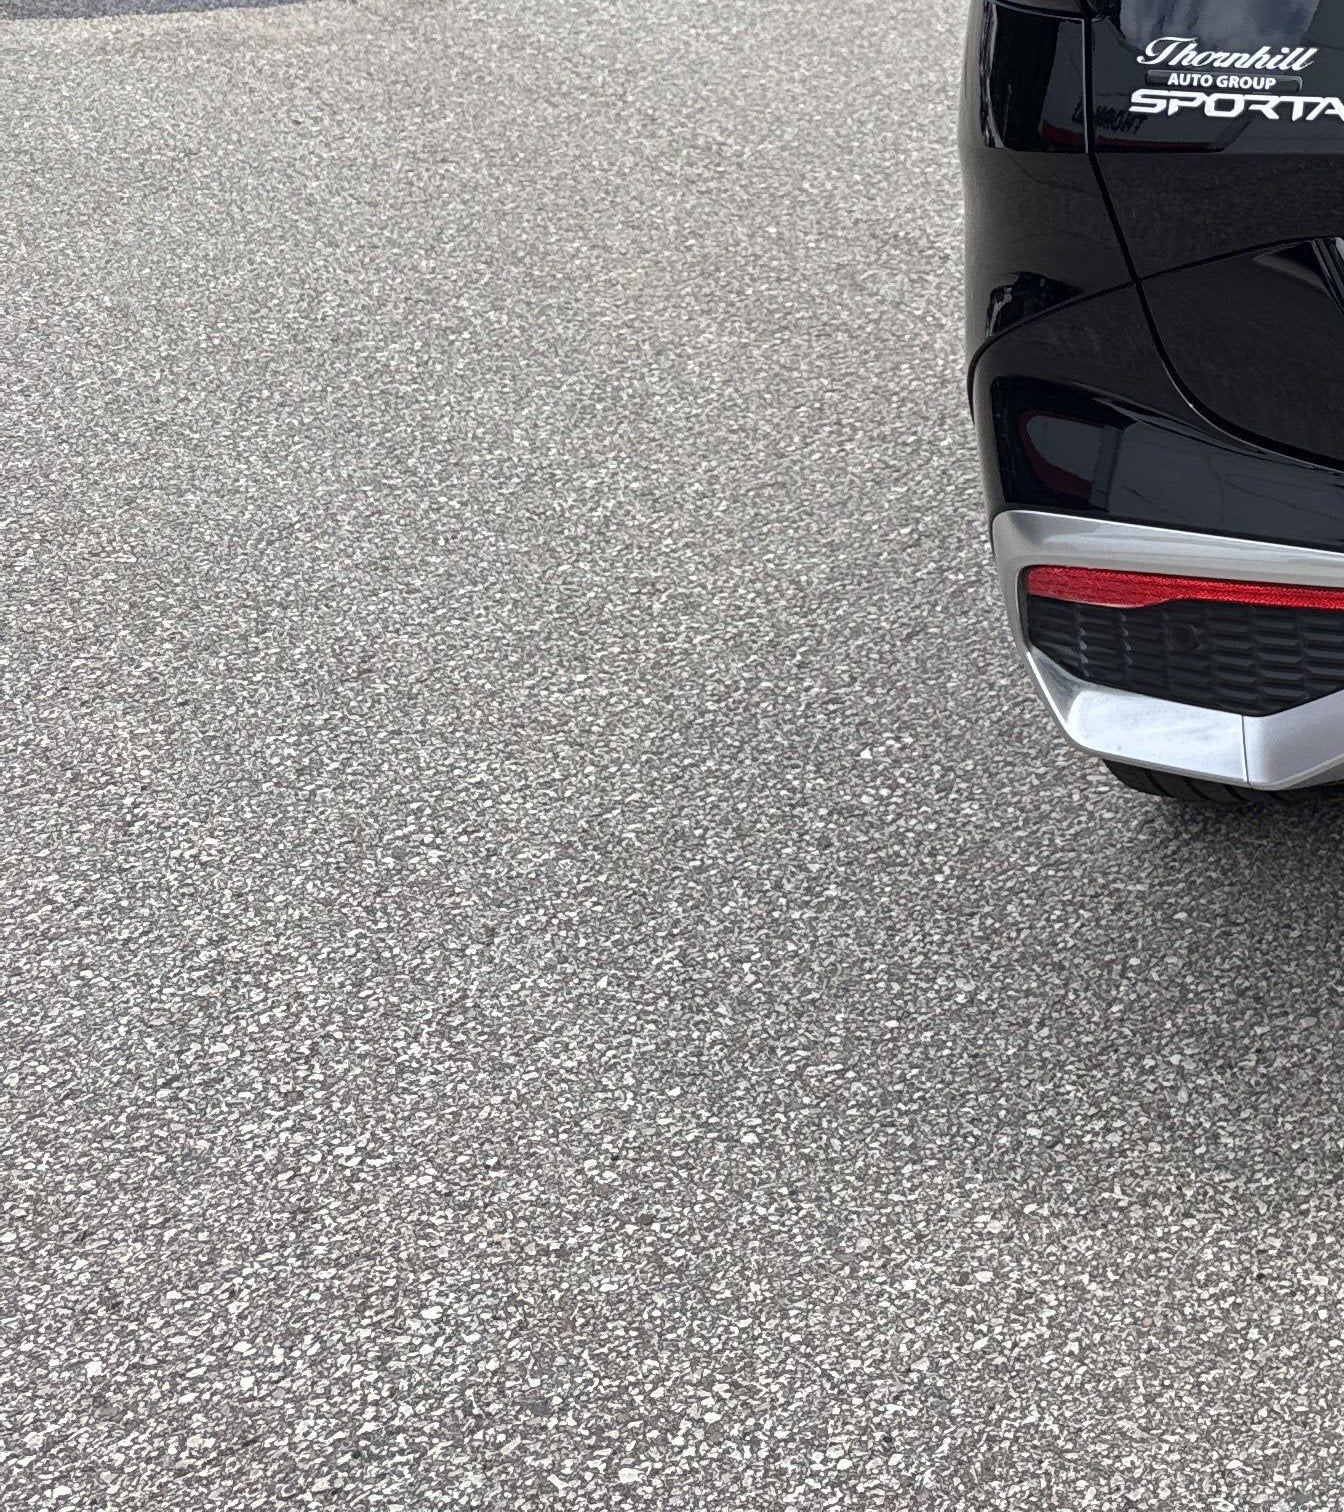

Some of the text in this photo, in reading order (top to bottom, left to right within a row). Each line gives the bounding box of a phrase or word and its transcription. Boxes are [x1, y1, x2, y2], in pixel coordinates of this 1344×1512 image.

[1136, 36, 1319, 71] Thornhill
[1167, 73, 1276, 90] AUTO GROUP
